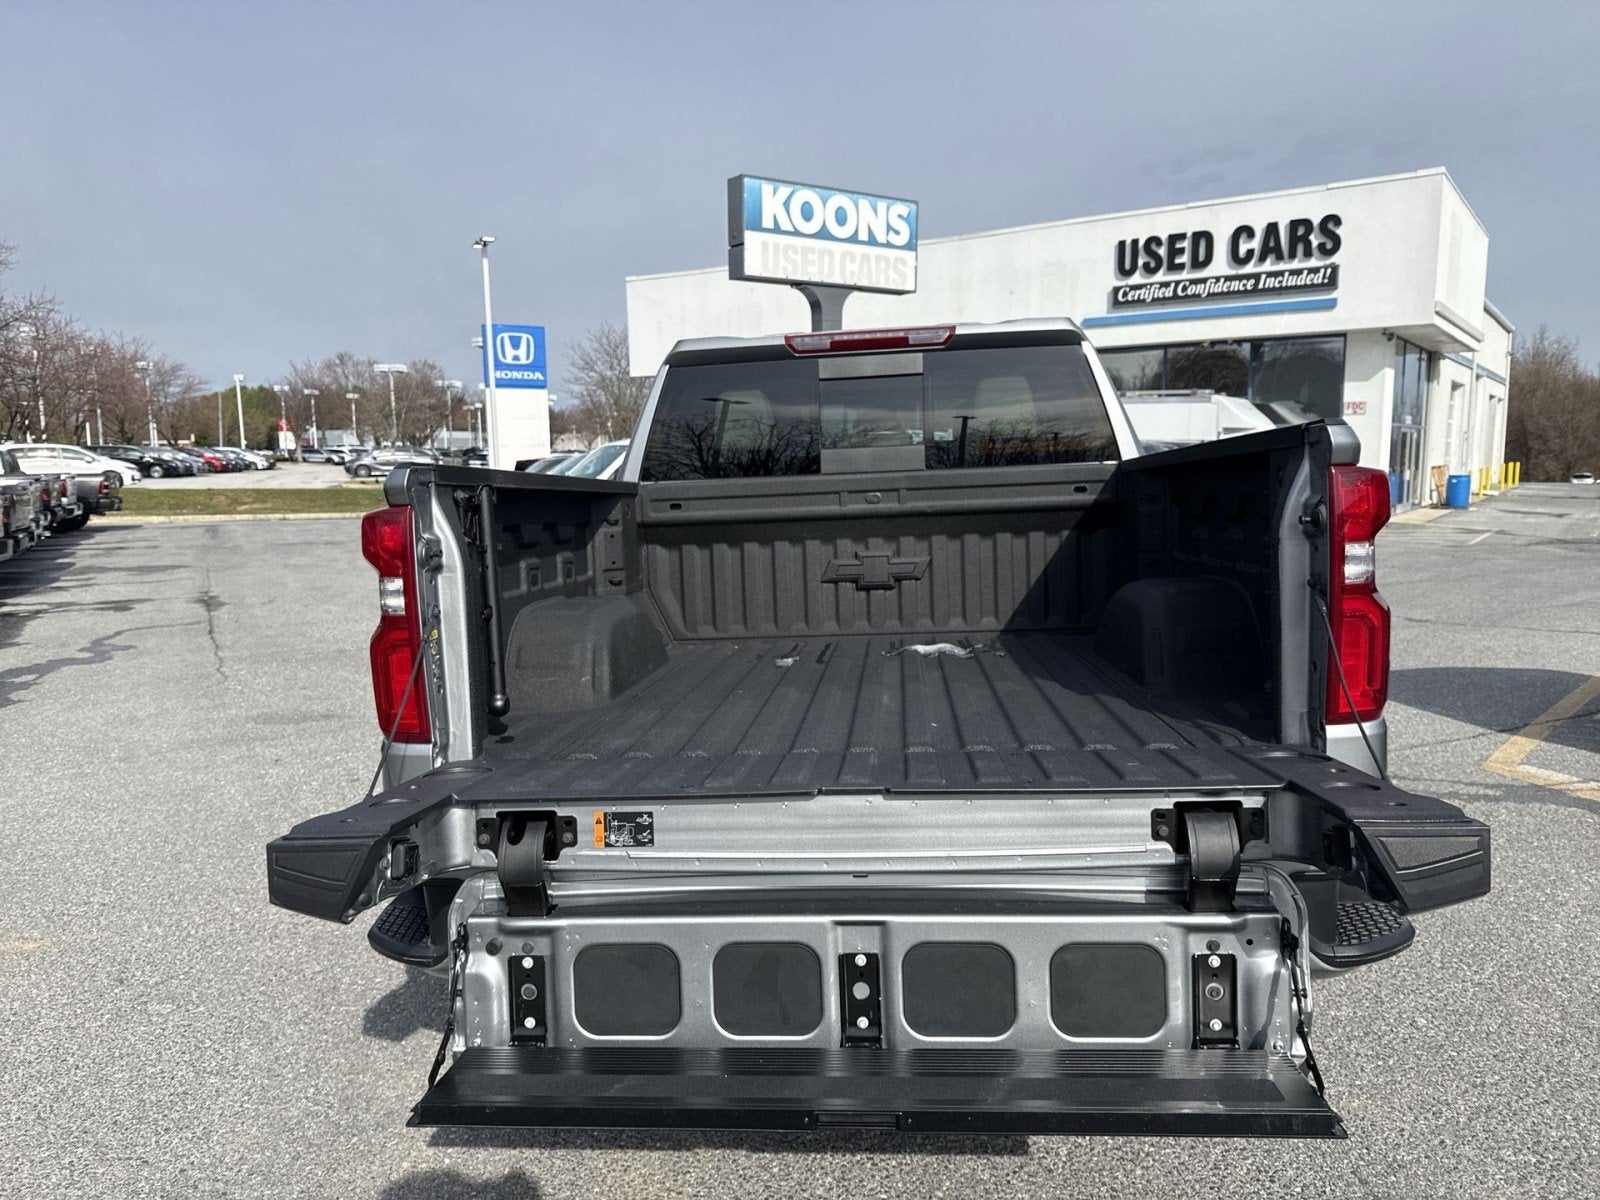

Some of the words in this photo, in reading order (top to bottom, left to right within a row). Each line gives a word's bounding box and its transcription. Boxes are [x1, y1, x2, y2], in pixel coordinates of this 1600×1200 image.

[761, 183, 910, 246] KOONS
[760, 240, 834, 282] USED
[839, 250, 908, 288] CARS
[1117, 230, 1214, 277] USED
[1230, 214, 1342, 266] CARS
[1117, 282, 1175, 303] Certified
[1177, 276, 1254, 298] Confidence
[1257, 268, 1333, 290] Included!
